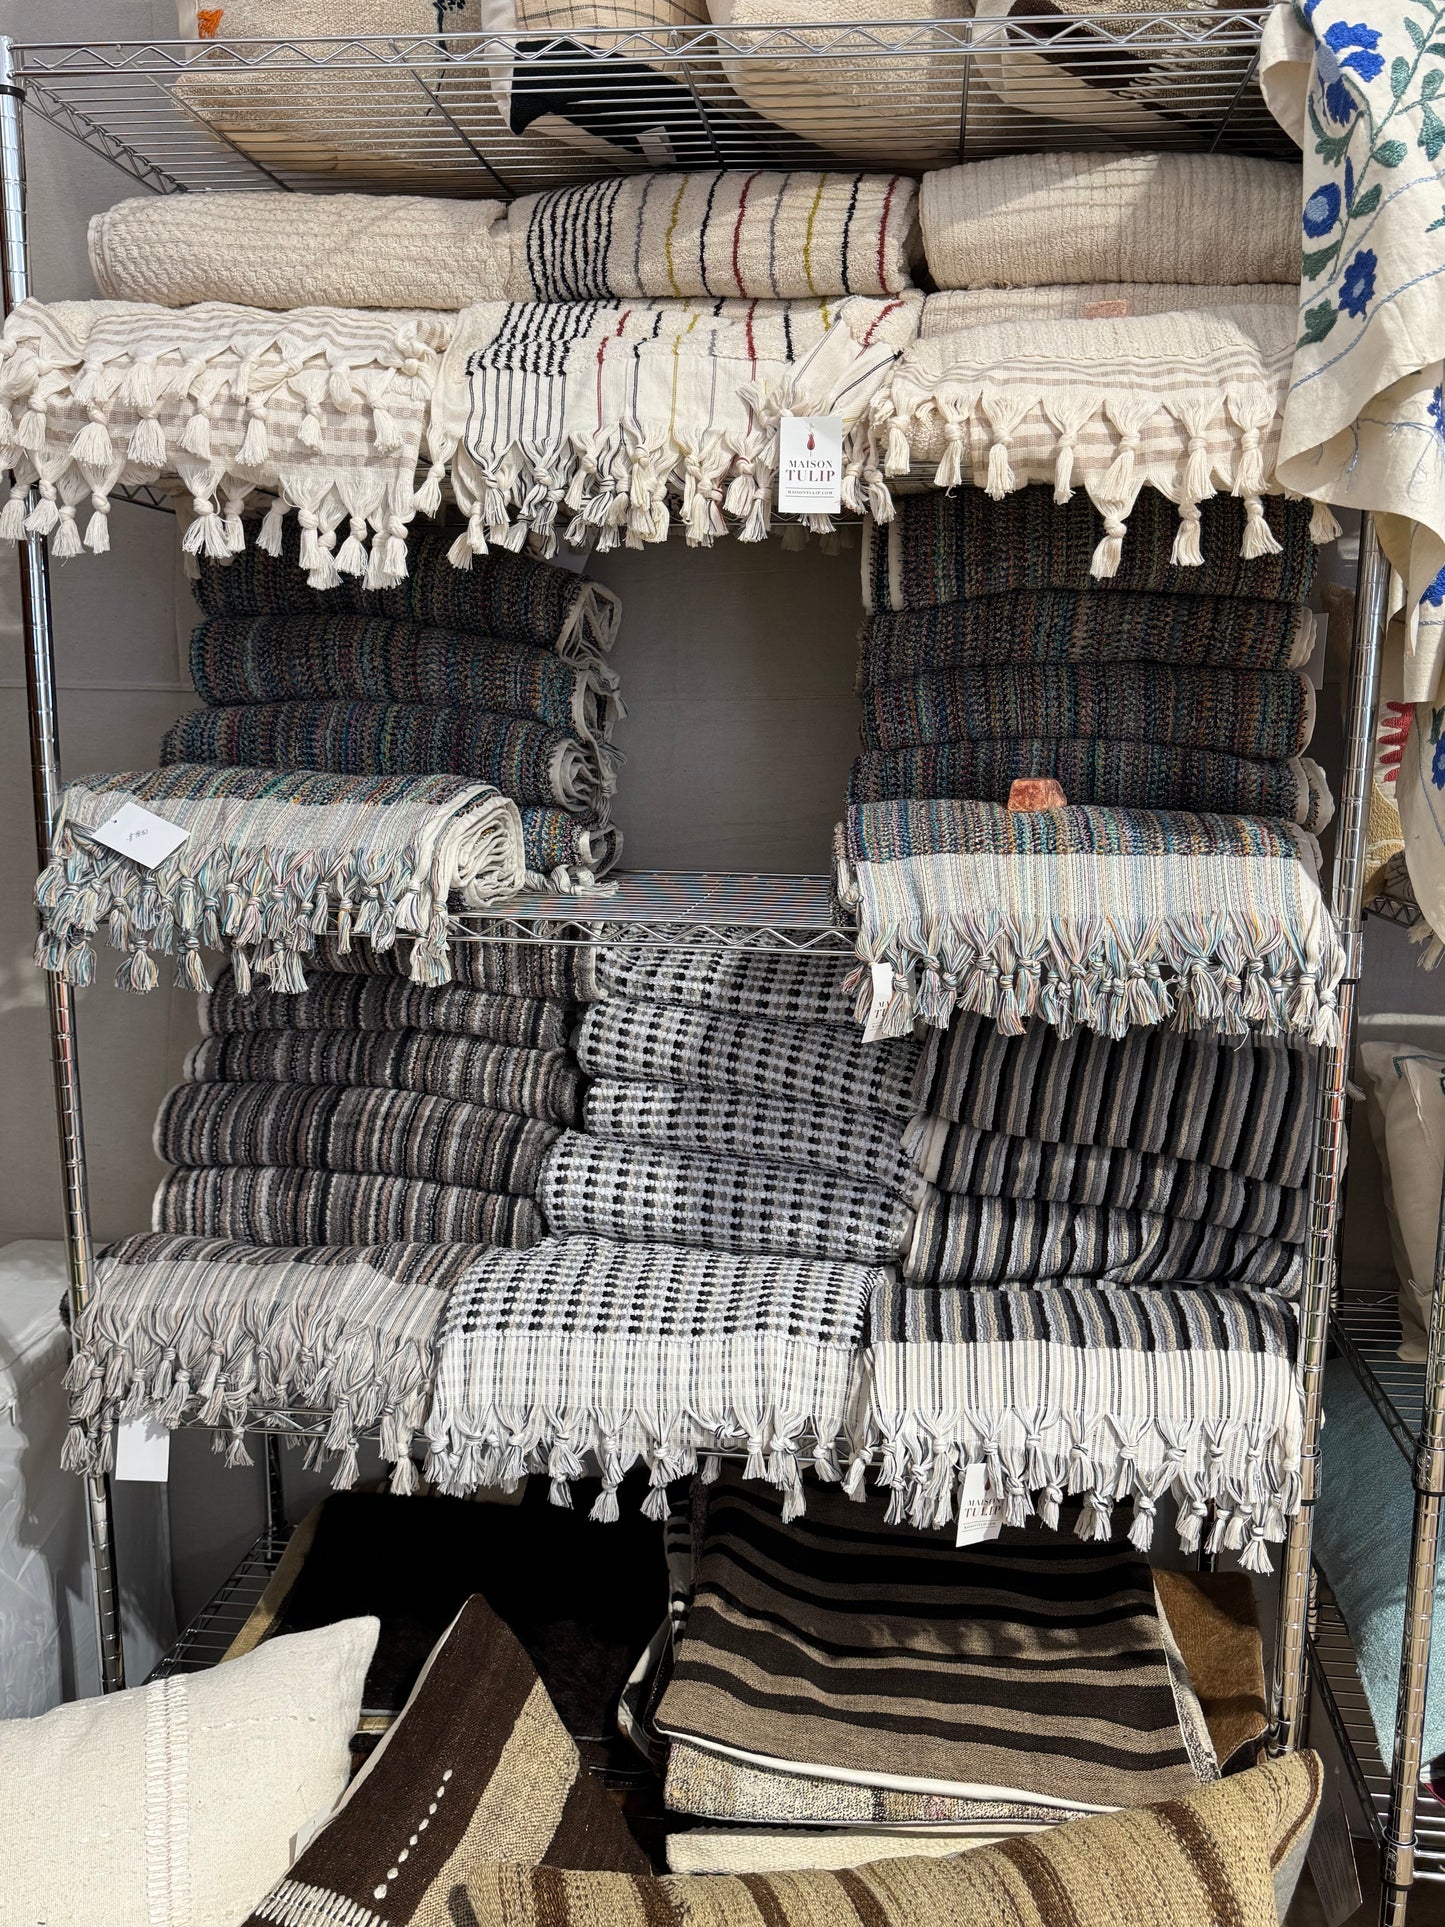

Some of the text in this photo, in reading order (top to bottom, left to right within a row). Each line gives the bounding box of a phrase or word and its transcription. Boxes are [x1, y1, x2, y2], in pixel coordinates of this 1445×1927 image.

[789, 460, 832, 468] MAISON
[785, 470, 835, 481] TULIP
[968, 1498, 1001, 1506] MAISON
[965, 1506, 1001, 1518] TULIP
